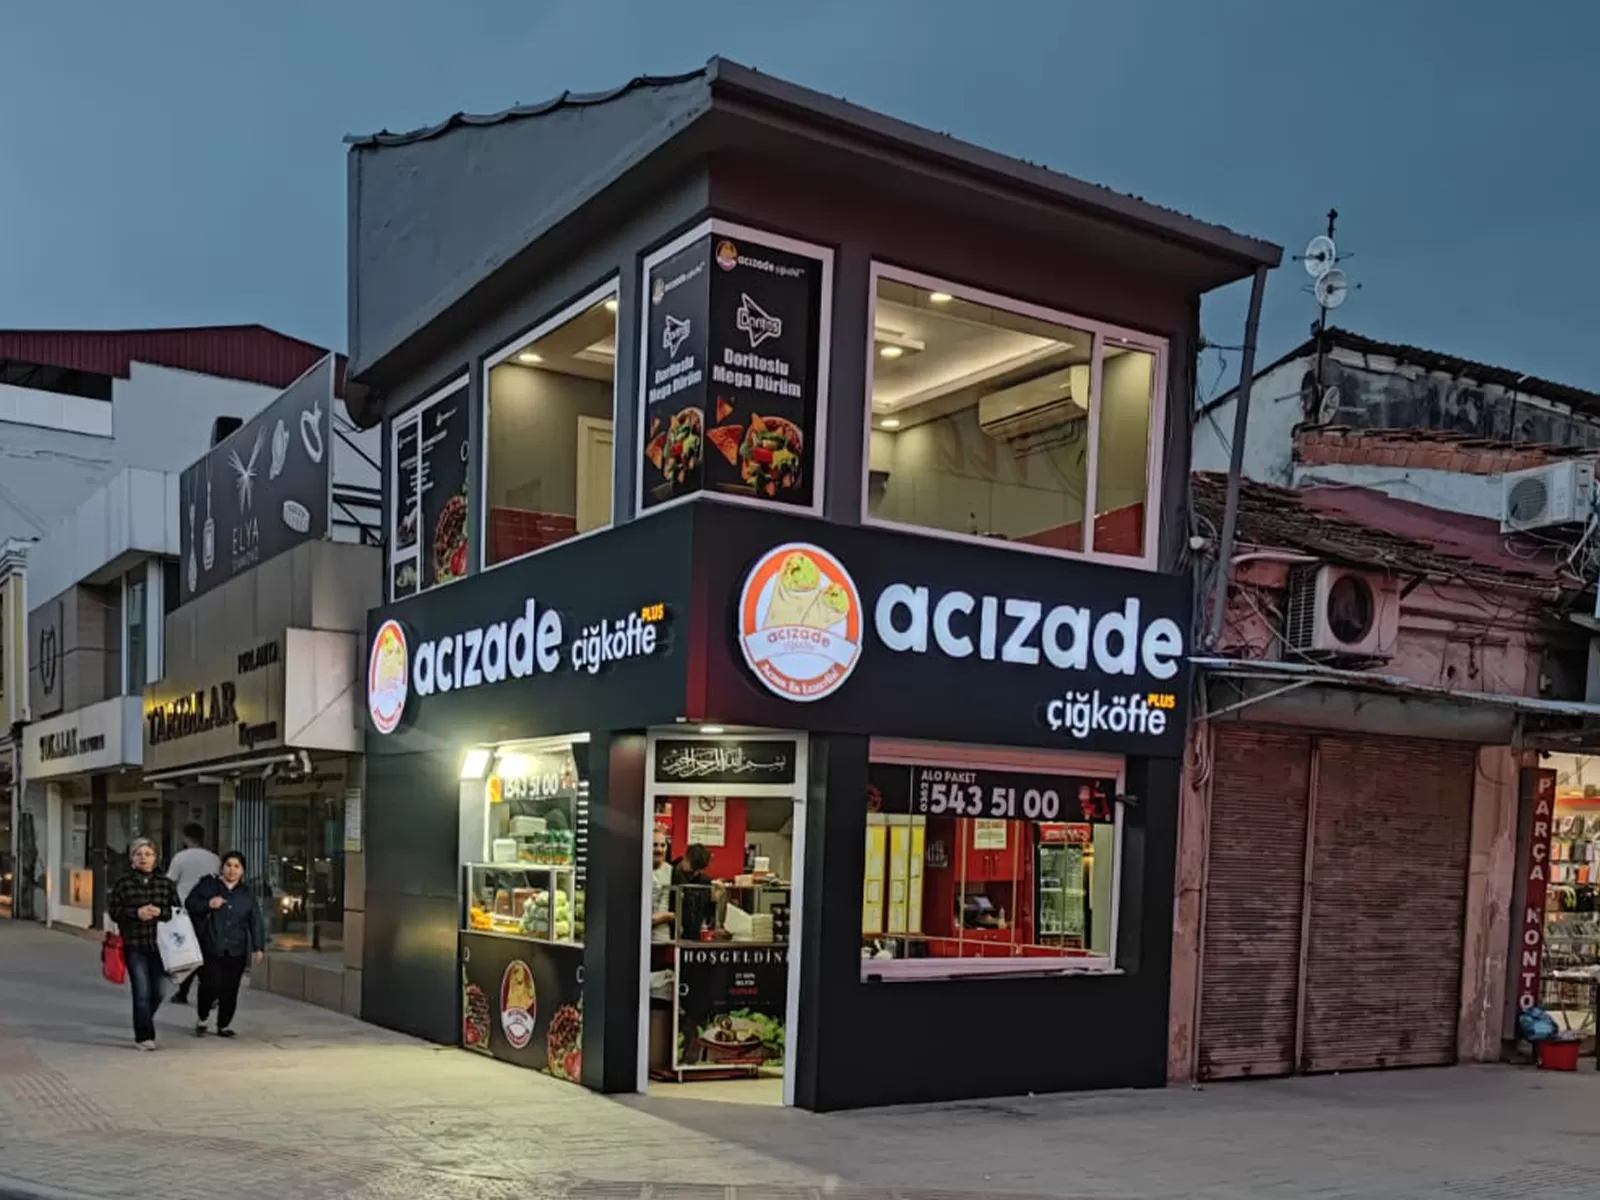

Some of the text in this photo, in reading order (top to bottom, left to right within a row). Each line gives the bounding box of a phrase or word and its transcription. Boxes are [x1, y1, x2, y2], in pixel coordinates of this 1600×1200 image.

[724, 348, 789, 376] Doritoslu
[712, 365, 801, 398] Mega Dürüm
[232, 516, 259, 554] ELYA
[413, 598, 665, 696] acızade çiğköfte PLUS
[875, 583, 1184, 681] acızade
[1046, 690, 1176, 738] çiğköfte PLUS
[921, 770, 977, 784] ALO PAKET
[930, 783, 983, 815] 543
[990, 787, 1015, 816] 51
[1023, 789, 1060, 818] 00
[1520, 776, 1554, 1012] PARÇA KONTÖ
